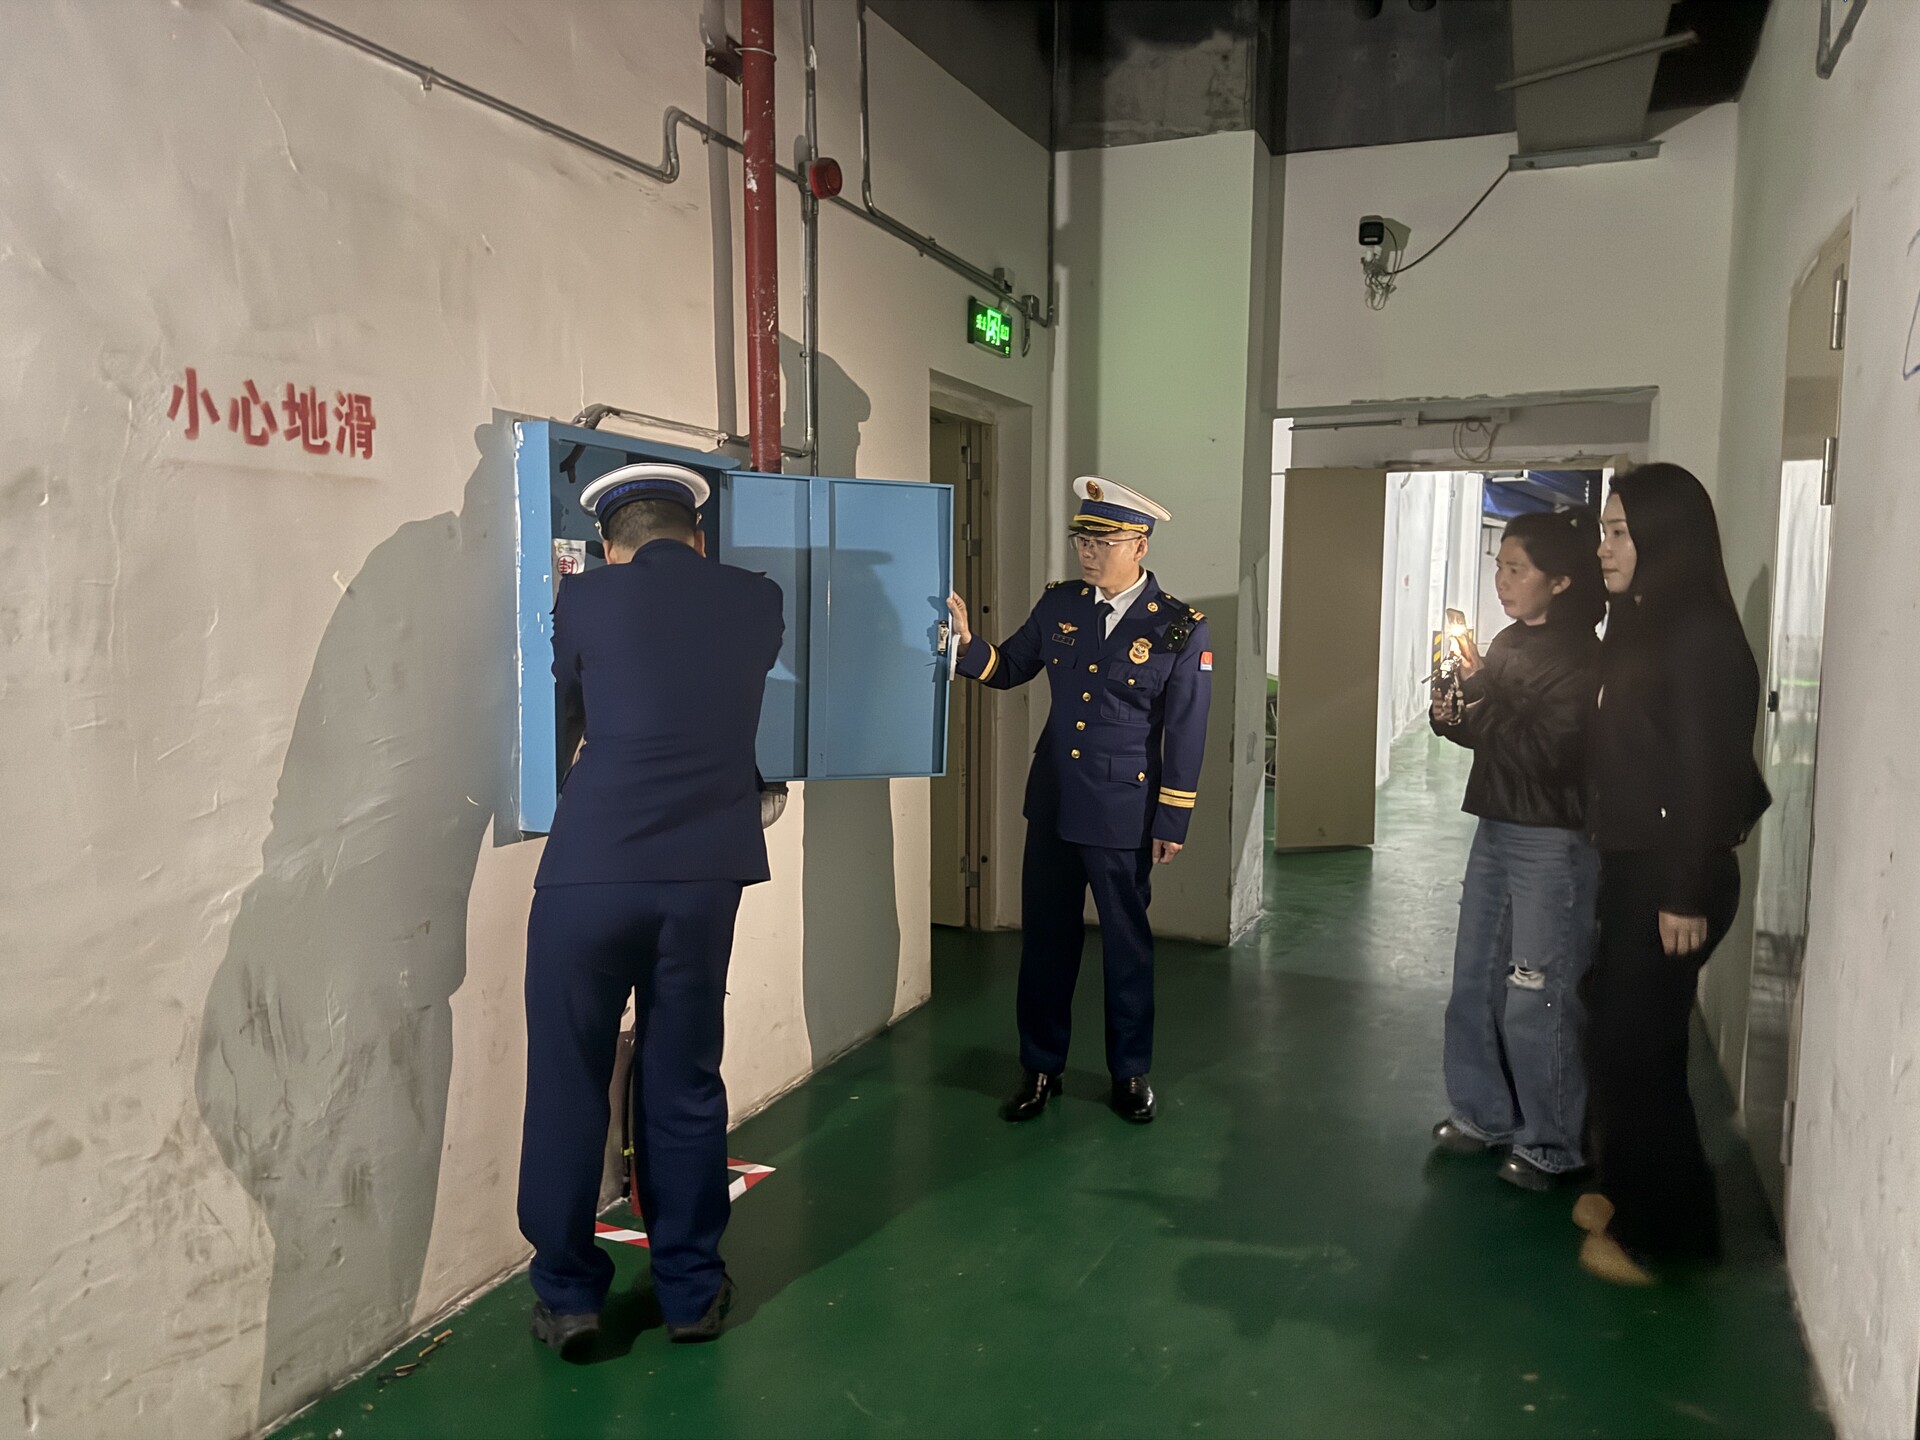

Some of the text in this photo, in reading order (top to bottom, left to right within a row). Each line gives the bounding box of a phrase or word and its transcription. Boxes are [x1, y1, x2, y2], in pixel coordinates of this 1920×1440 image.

[167, 367, 376, 460] 小心地滑
[559, 558, 575, 575] 封
